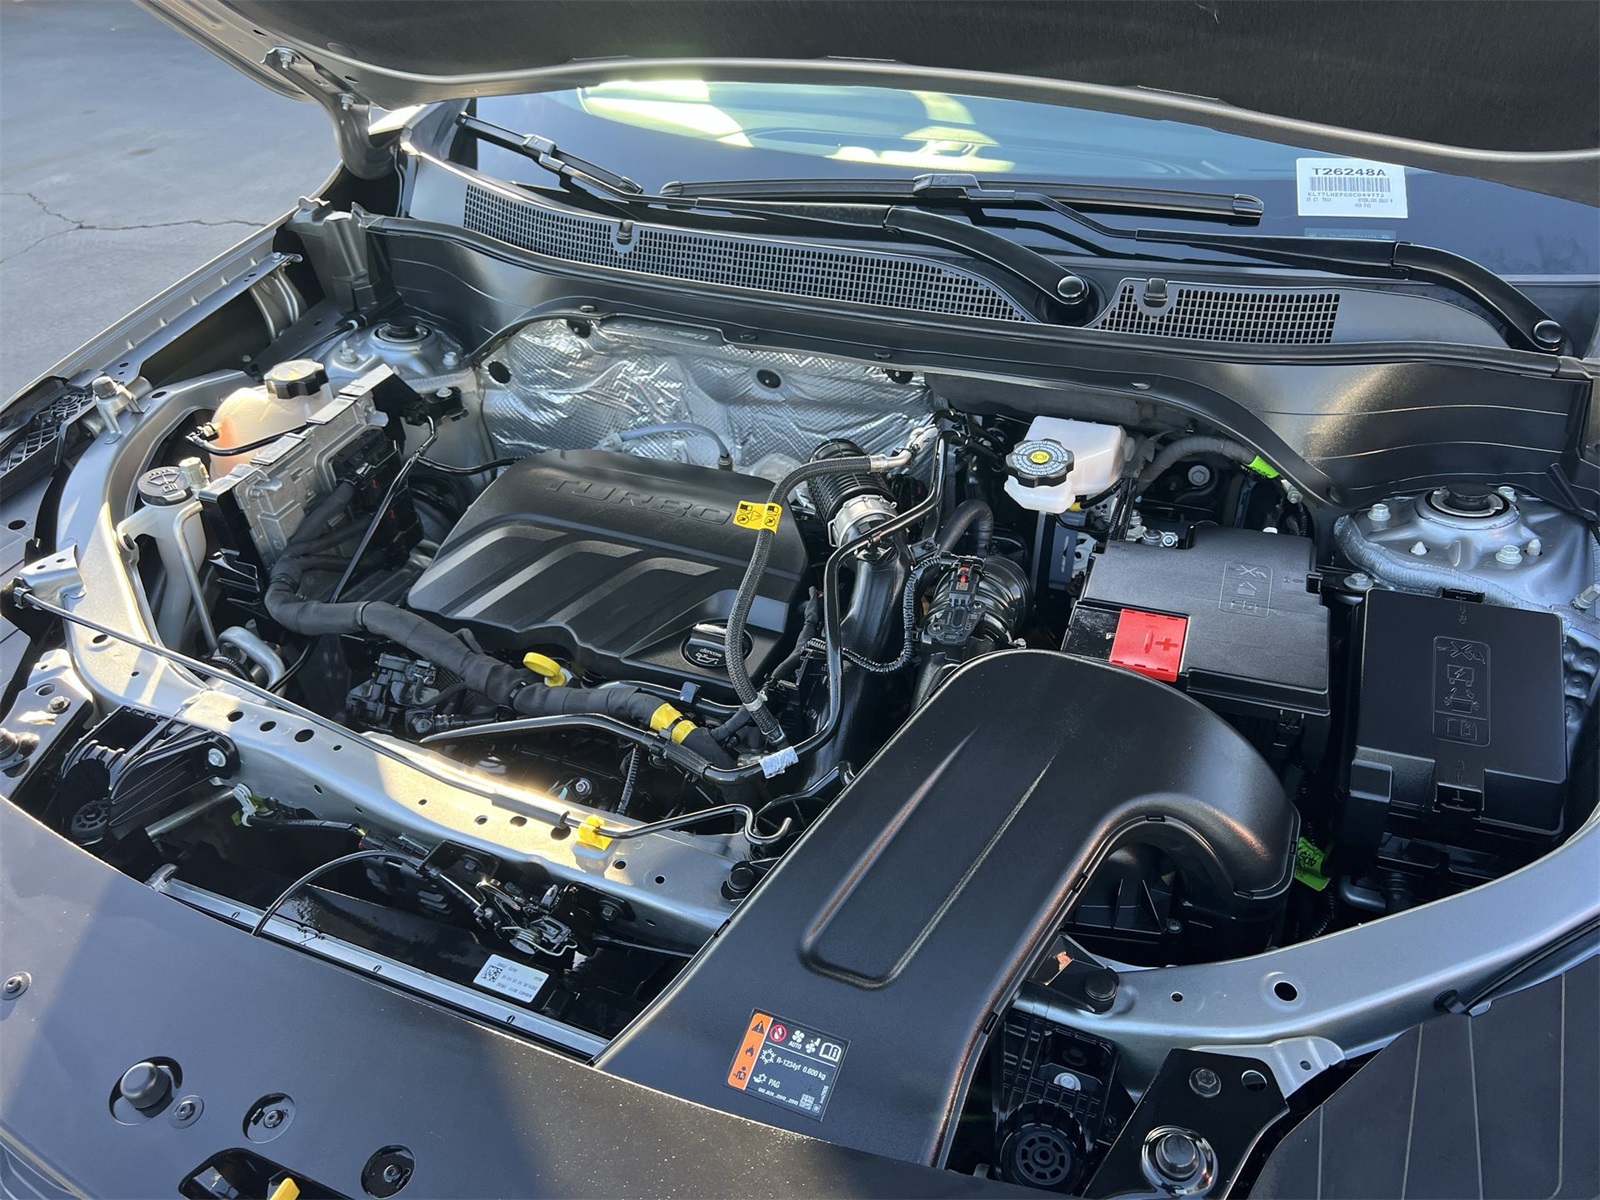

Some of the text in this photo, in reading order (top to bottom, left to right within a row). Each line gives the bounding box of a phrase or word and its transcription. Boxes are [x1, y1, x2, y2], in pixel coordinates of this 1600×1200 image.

[1311, 167, 1387, 177] T26248A
[546, 476, 732, 526] TURBO
[788, 1040, 803, 1050] AUTO
[775, 1056, 827, 1081] R-1234yf 0.600 kg
[767, 1078, 781, 1089] PAG
